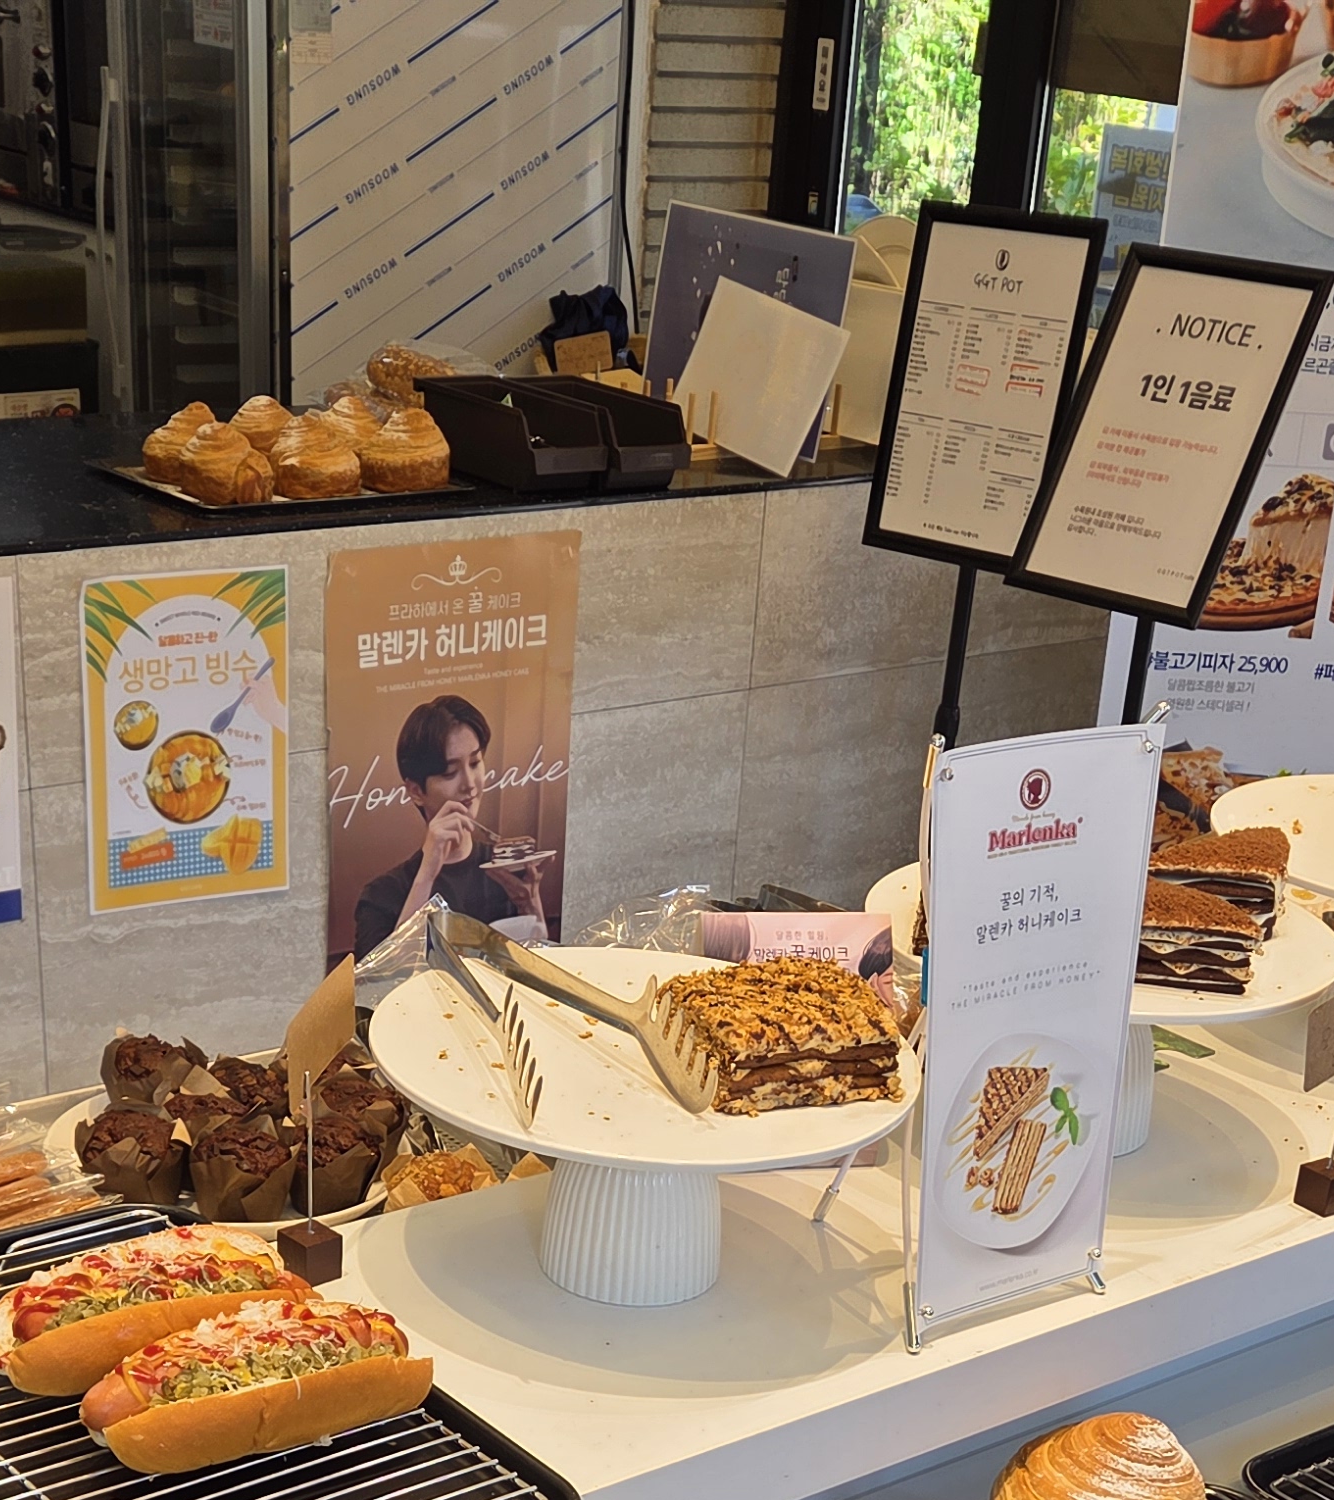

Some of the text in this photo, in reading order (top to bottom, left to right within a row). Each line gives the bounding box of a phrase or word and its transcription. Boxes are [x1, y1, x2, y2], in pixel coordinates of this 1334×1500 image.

[346, 63, 401, 107] WOOSUNG
[503, 54, 554, 96] WOOSUNG
[345, 162, 400, 205] WOOSUNG
[500, 150, 550, 192] WOOSUNG
[344, 257, 398, 299] WOOSUNG
[497, 242, 547, 283] WOOSUNG
[973, 273, 1023, 294] GGT POT
[1170, 314, 1256, 348] NOTICE
[1139, 373, 1238, 413] 1인 1음료
[453, 597, 464, 615] 온
[469, 586, 484, 614] 꿀
[358, 614, 548, 669] 말렌카 허니케이크
[118, 650, 258, 694] 생망고 빙수
[1237, 655, 1289, 675] 25,900
[988, 818, 1078, 852] Marlenka
[999, 887, 1025, 911] 꿀의
[976, 908, 1083, 944] 말렌카 허니케이크
